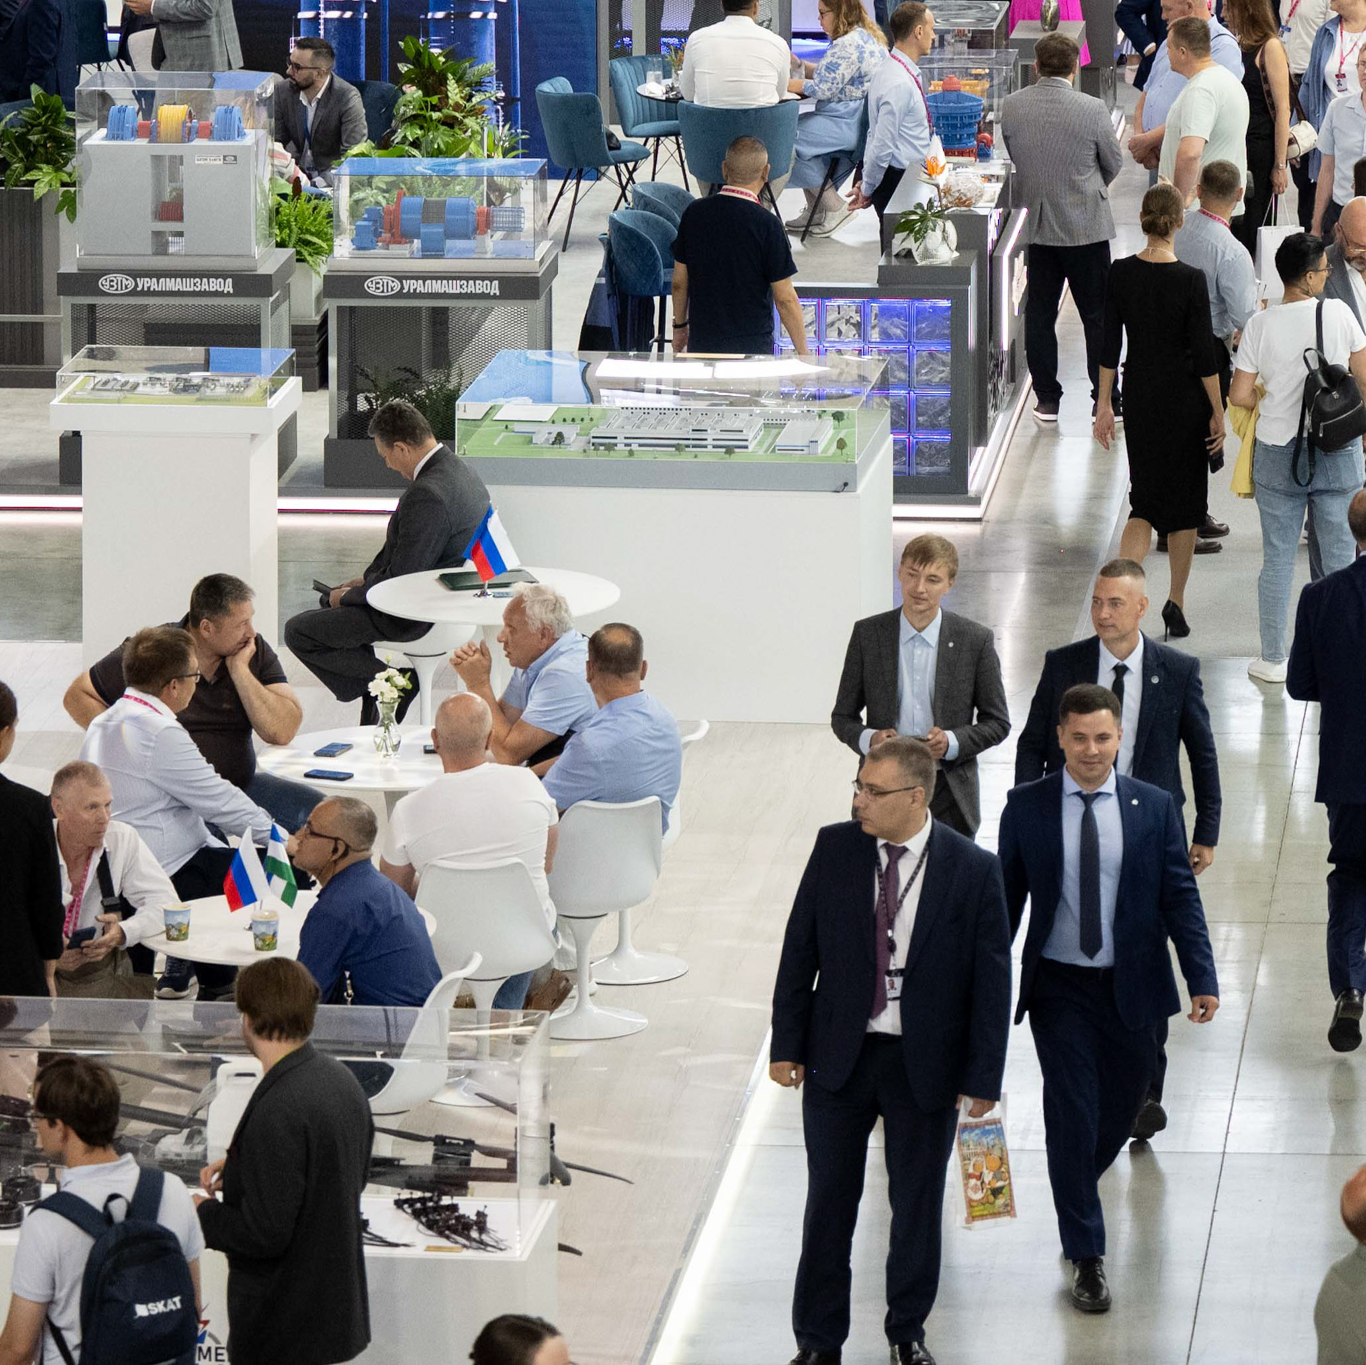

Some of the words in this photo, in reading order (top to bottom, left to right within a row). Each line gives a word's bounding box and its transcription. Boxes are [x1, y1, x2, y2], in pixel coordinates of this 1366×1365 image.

[136, 277, 234, 294] УРАЛМАШЗАВОД
[402, 279, 500, 296] УРАЛМАШЗАВОД
[147, 1295, 182, 1315] SKAT
